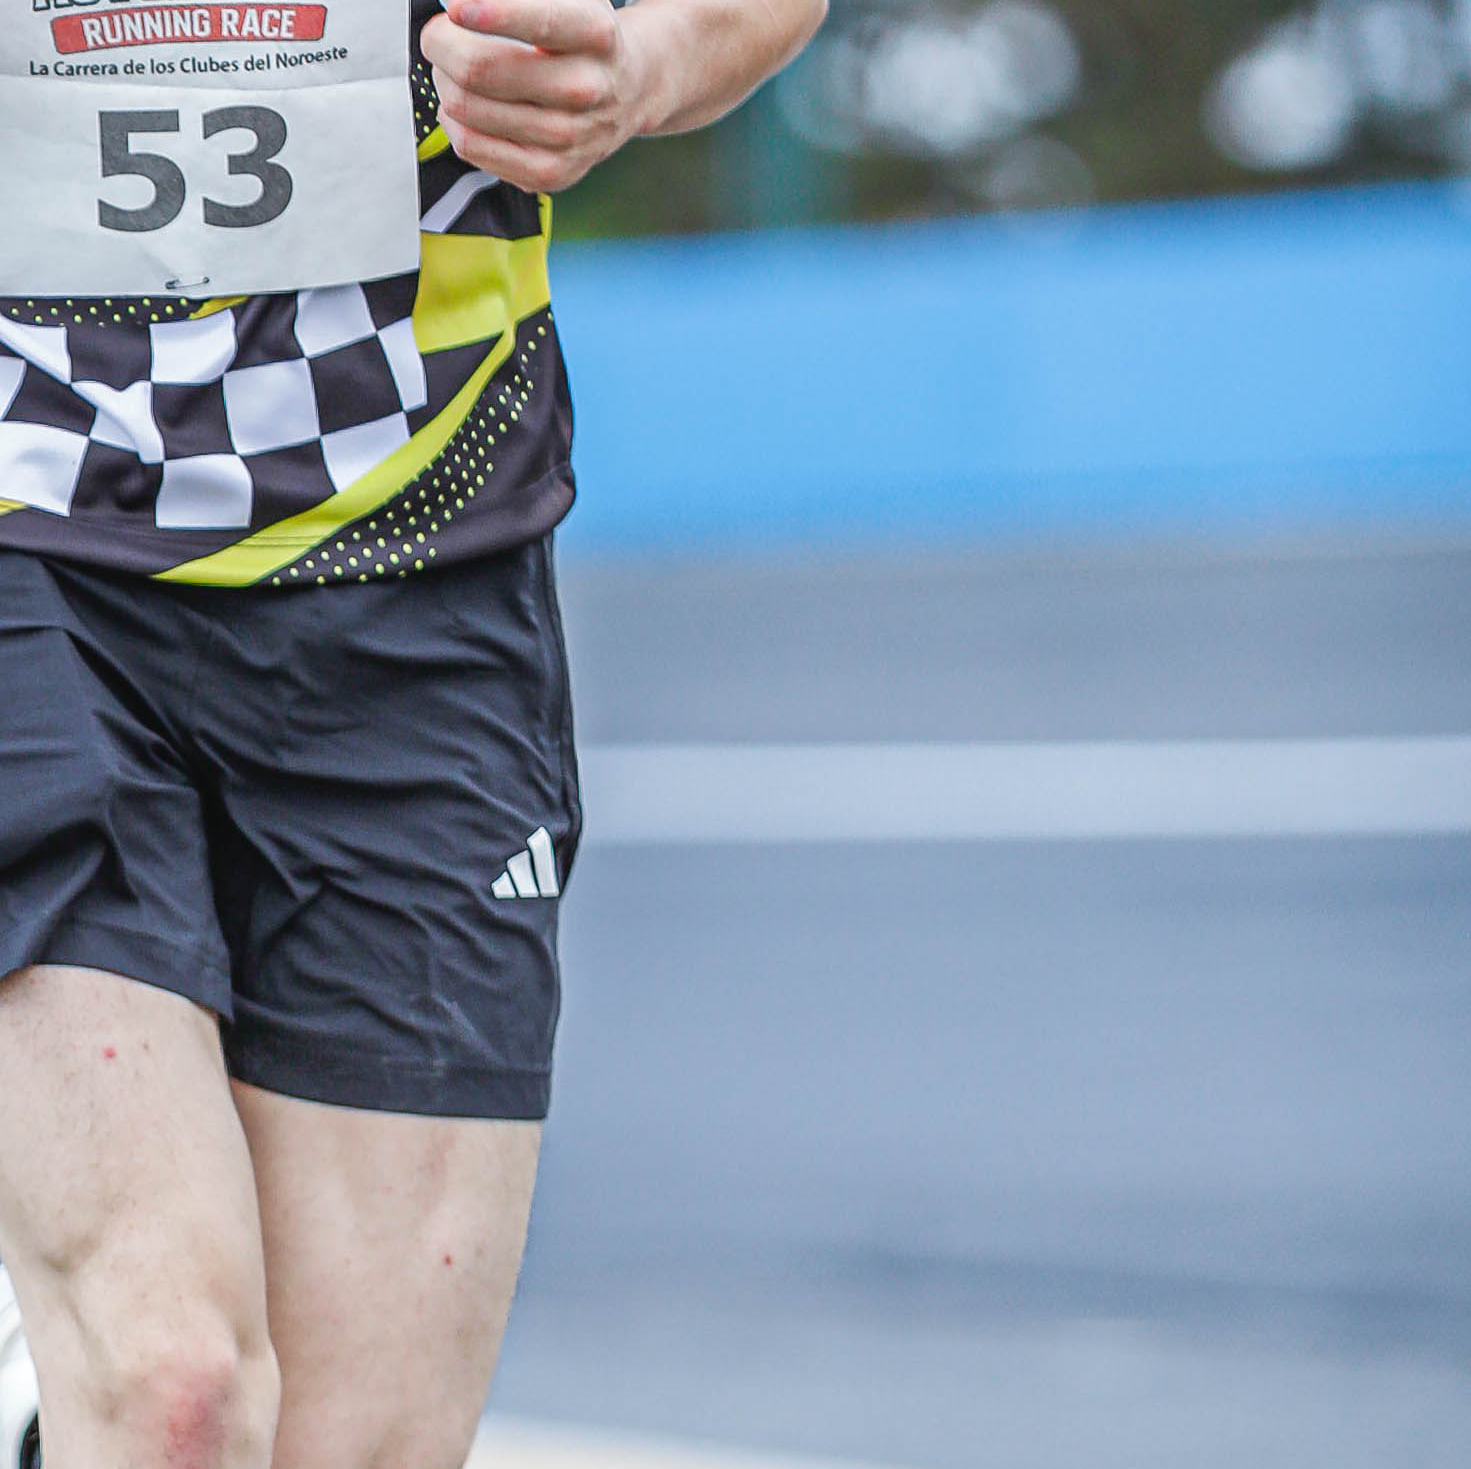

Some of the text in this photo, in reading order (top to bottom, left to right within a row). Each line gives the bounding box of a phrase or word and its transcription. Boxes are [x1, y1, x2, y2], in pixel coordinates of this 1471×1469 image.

[80, 7, 297, 50] RUNNING RACE
[29, 46, 349, 77] La Carrera de los Clubes del Noroeste
[96, 104, 293, 233] 53
